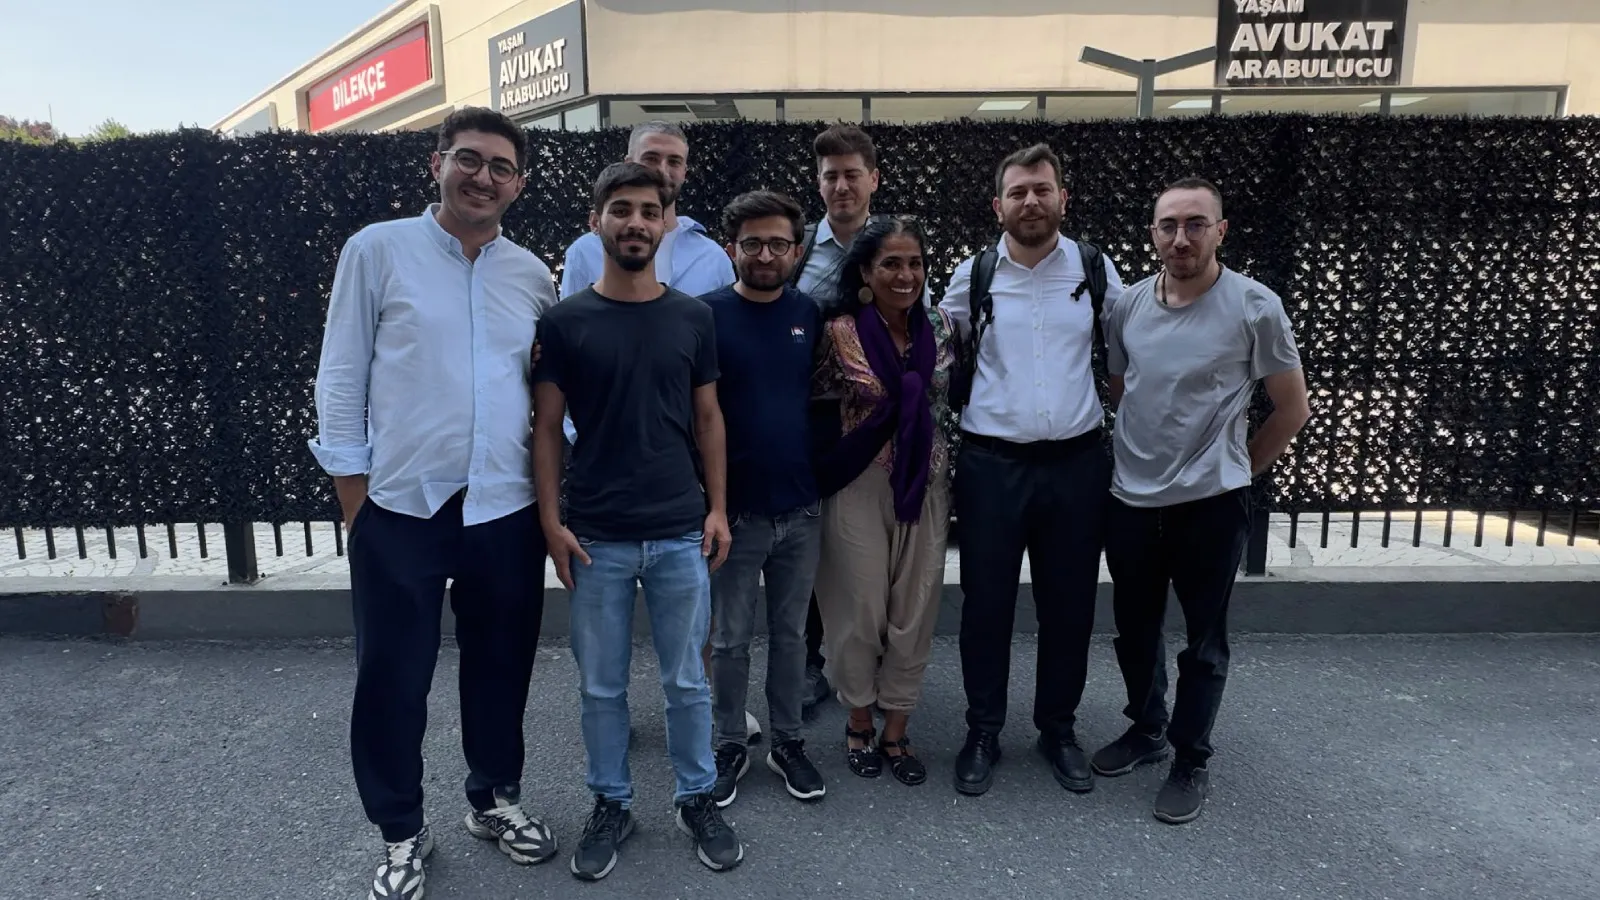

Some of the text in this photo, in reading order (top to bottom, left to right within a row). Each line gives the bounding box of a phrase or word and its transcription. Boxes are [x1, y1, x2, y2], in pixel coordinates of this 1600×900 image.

[1236, 0, 1303, 17] YAŞAM
[497, 32, 524, 55] YAŞAM
[1230, 21, 1393, 51] AVUKAT
[499, 38, 565, 87] AVUKAT
[1225, 58, 1393, 79] ARABULUCU
[332, 61, 386, 110] DİLEKÇE
[500, 72, 568, 109] ARABULUCU
